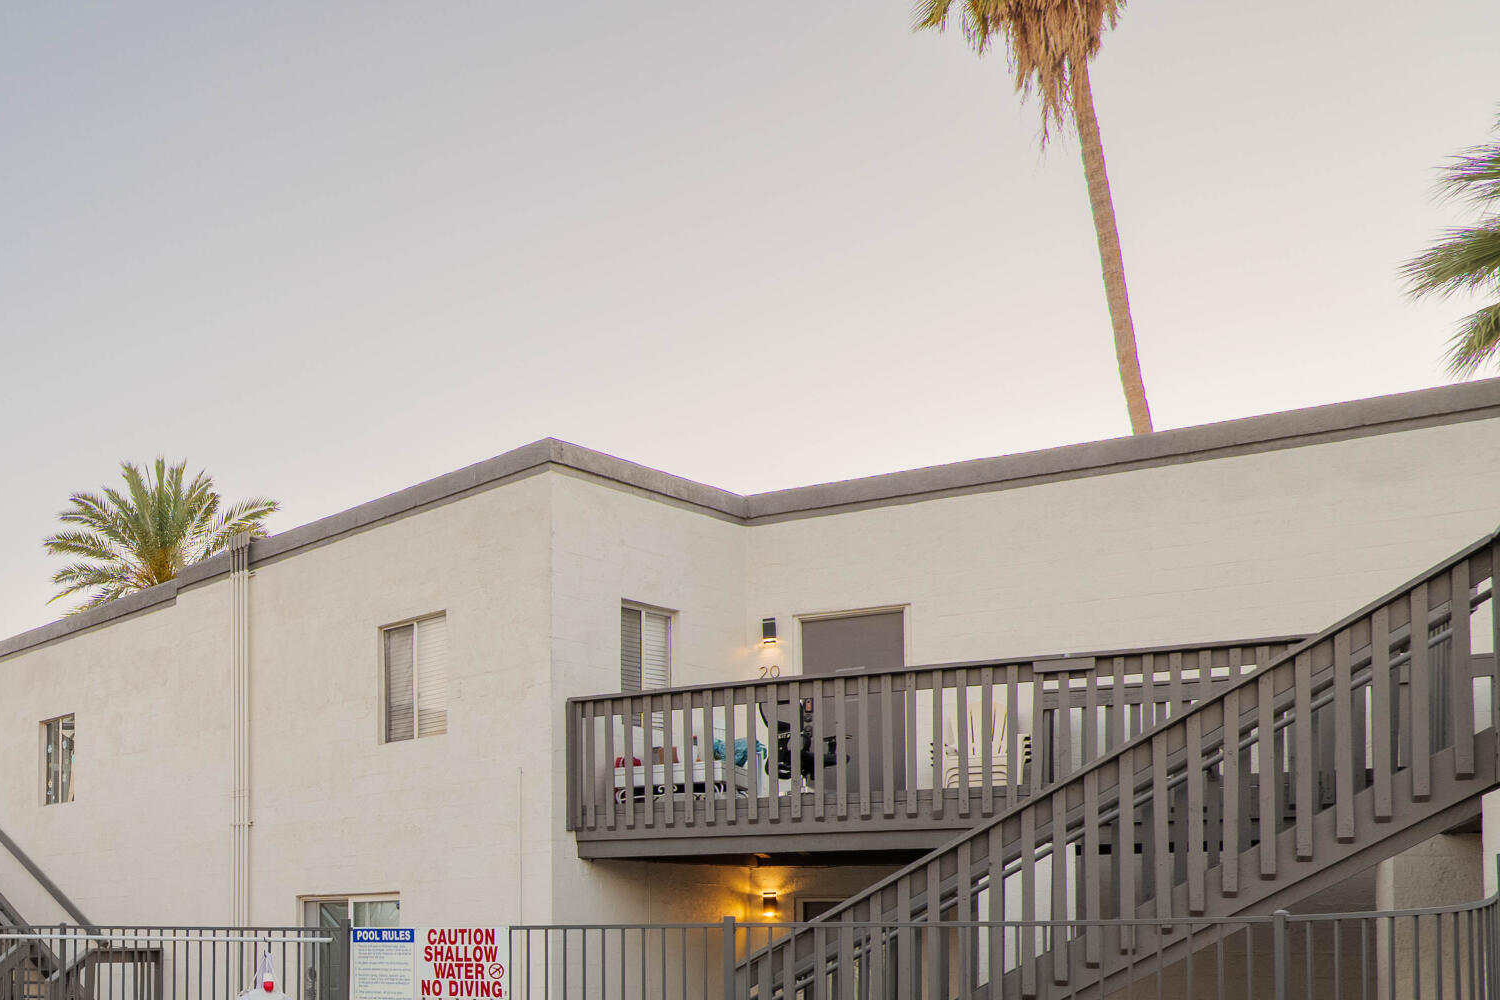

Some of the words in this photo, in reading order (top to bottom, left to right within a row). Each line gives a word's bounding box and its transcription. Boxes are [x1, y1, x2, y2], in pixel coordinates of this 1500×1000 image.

[759, 665, 780, 679] 20
[356, 930, 380, 941] POOL
[382, 930, 411, 941] RULES
[427, 928, 495, 945] CAUTION
[424, 945, 498, 962] SHALLOW
[433, 963, 485, 979] WATER
[421, 979, 442, 996] NO
[449, 980, 503, 998] DIVING
